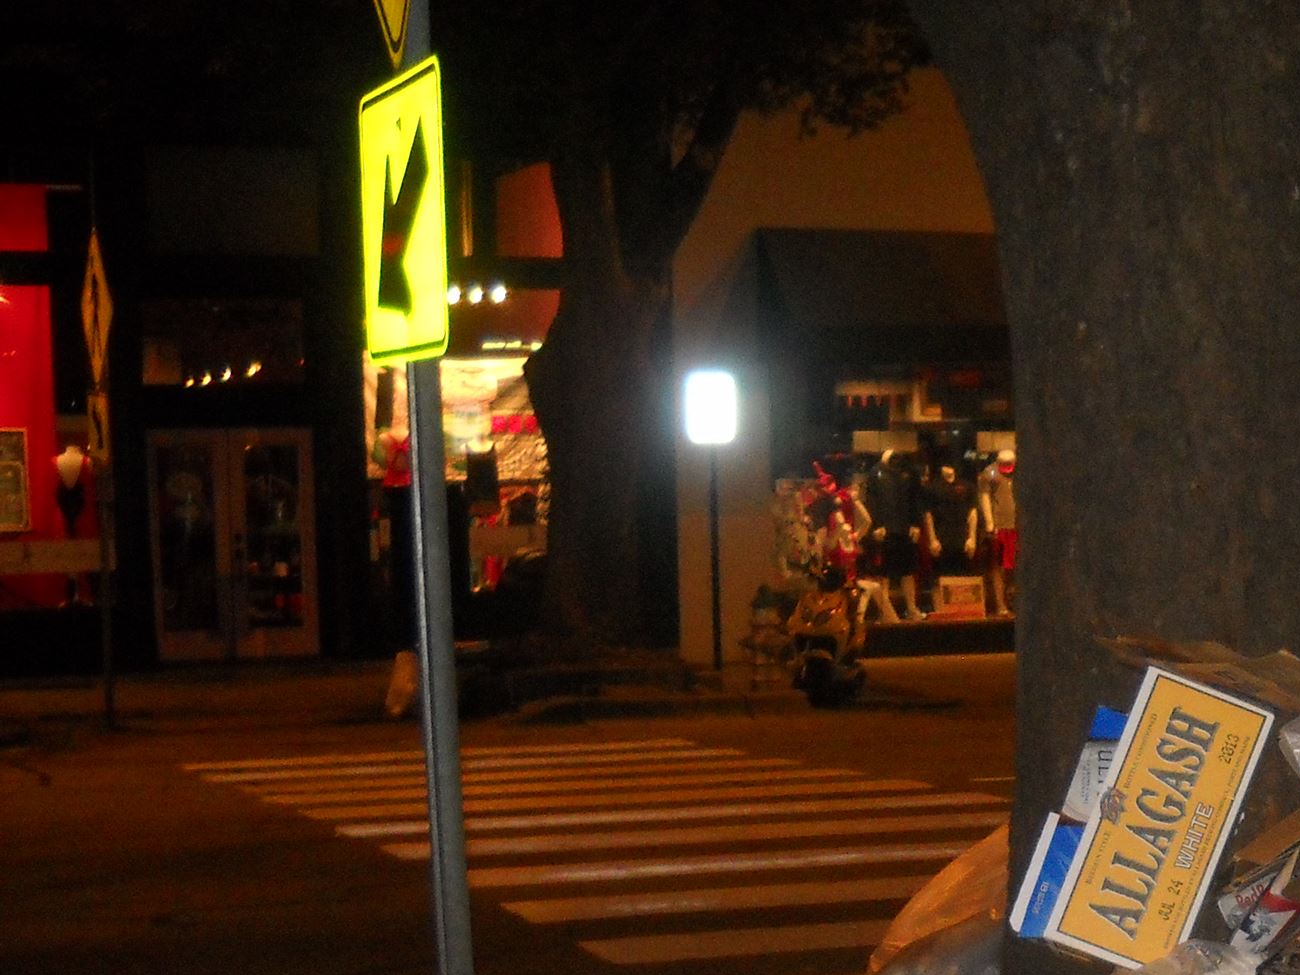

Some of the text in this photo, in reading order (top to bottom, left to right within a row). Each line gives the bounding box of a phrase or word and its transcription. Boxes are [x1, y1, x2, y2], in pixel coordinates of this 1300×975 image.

[1088, 704, 1221, 942] ALLAGASH
[1160, 733, 1240, 921] JUL 24 2013
[1174, 801, 1215, 870] WHITE
